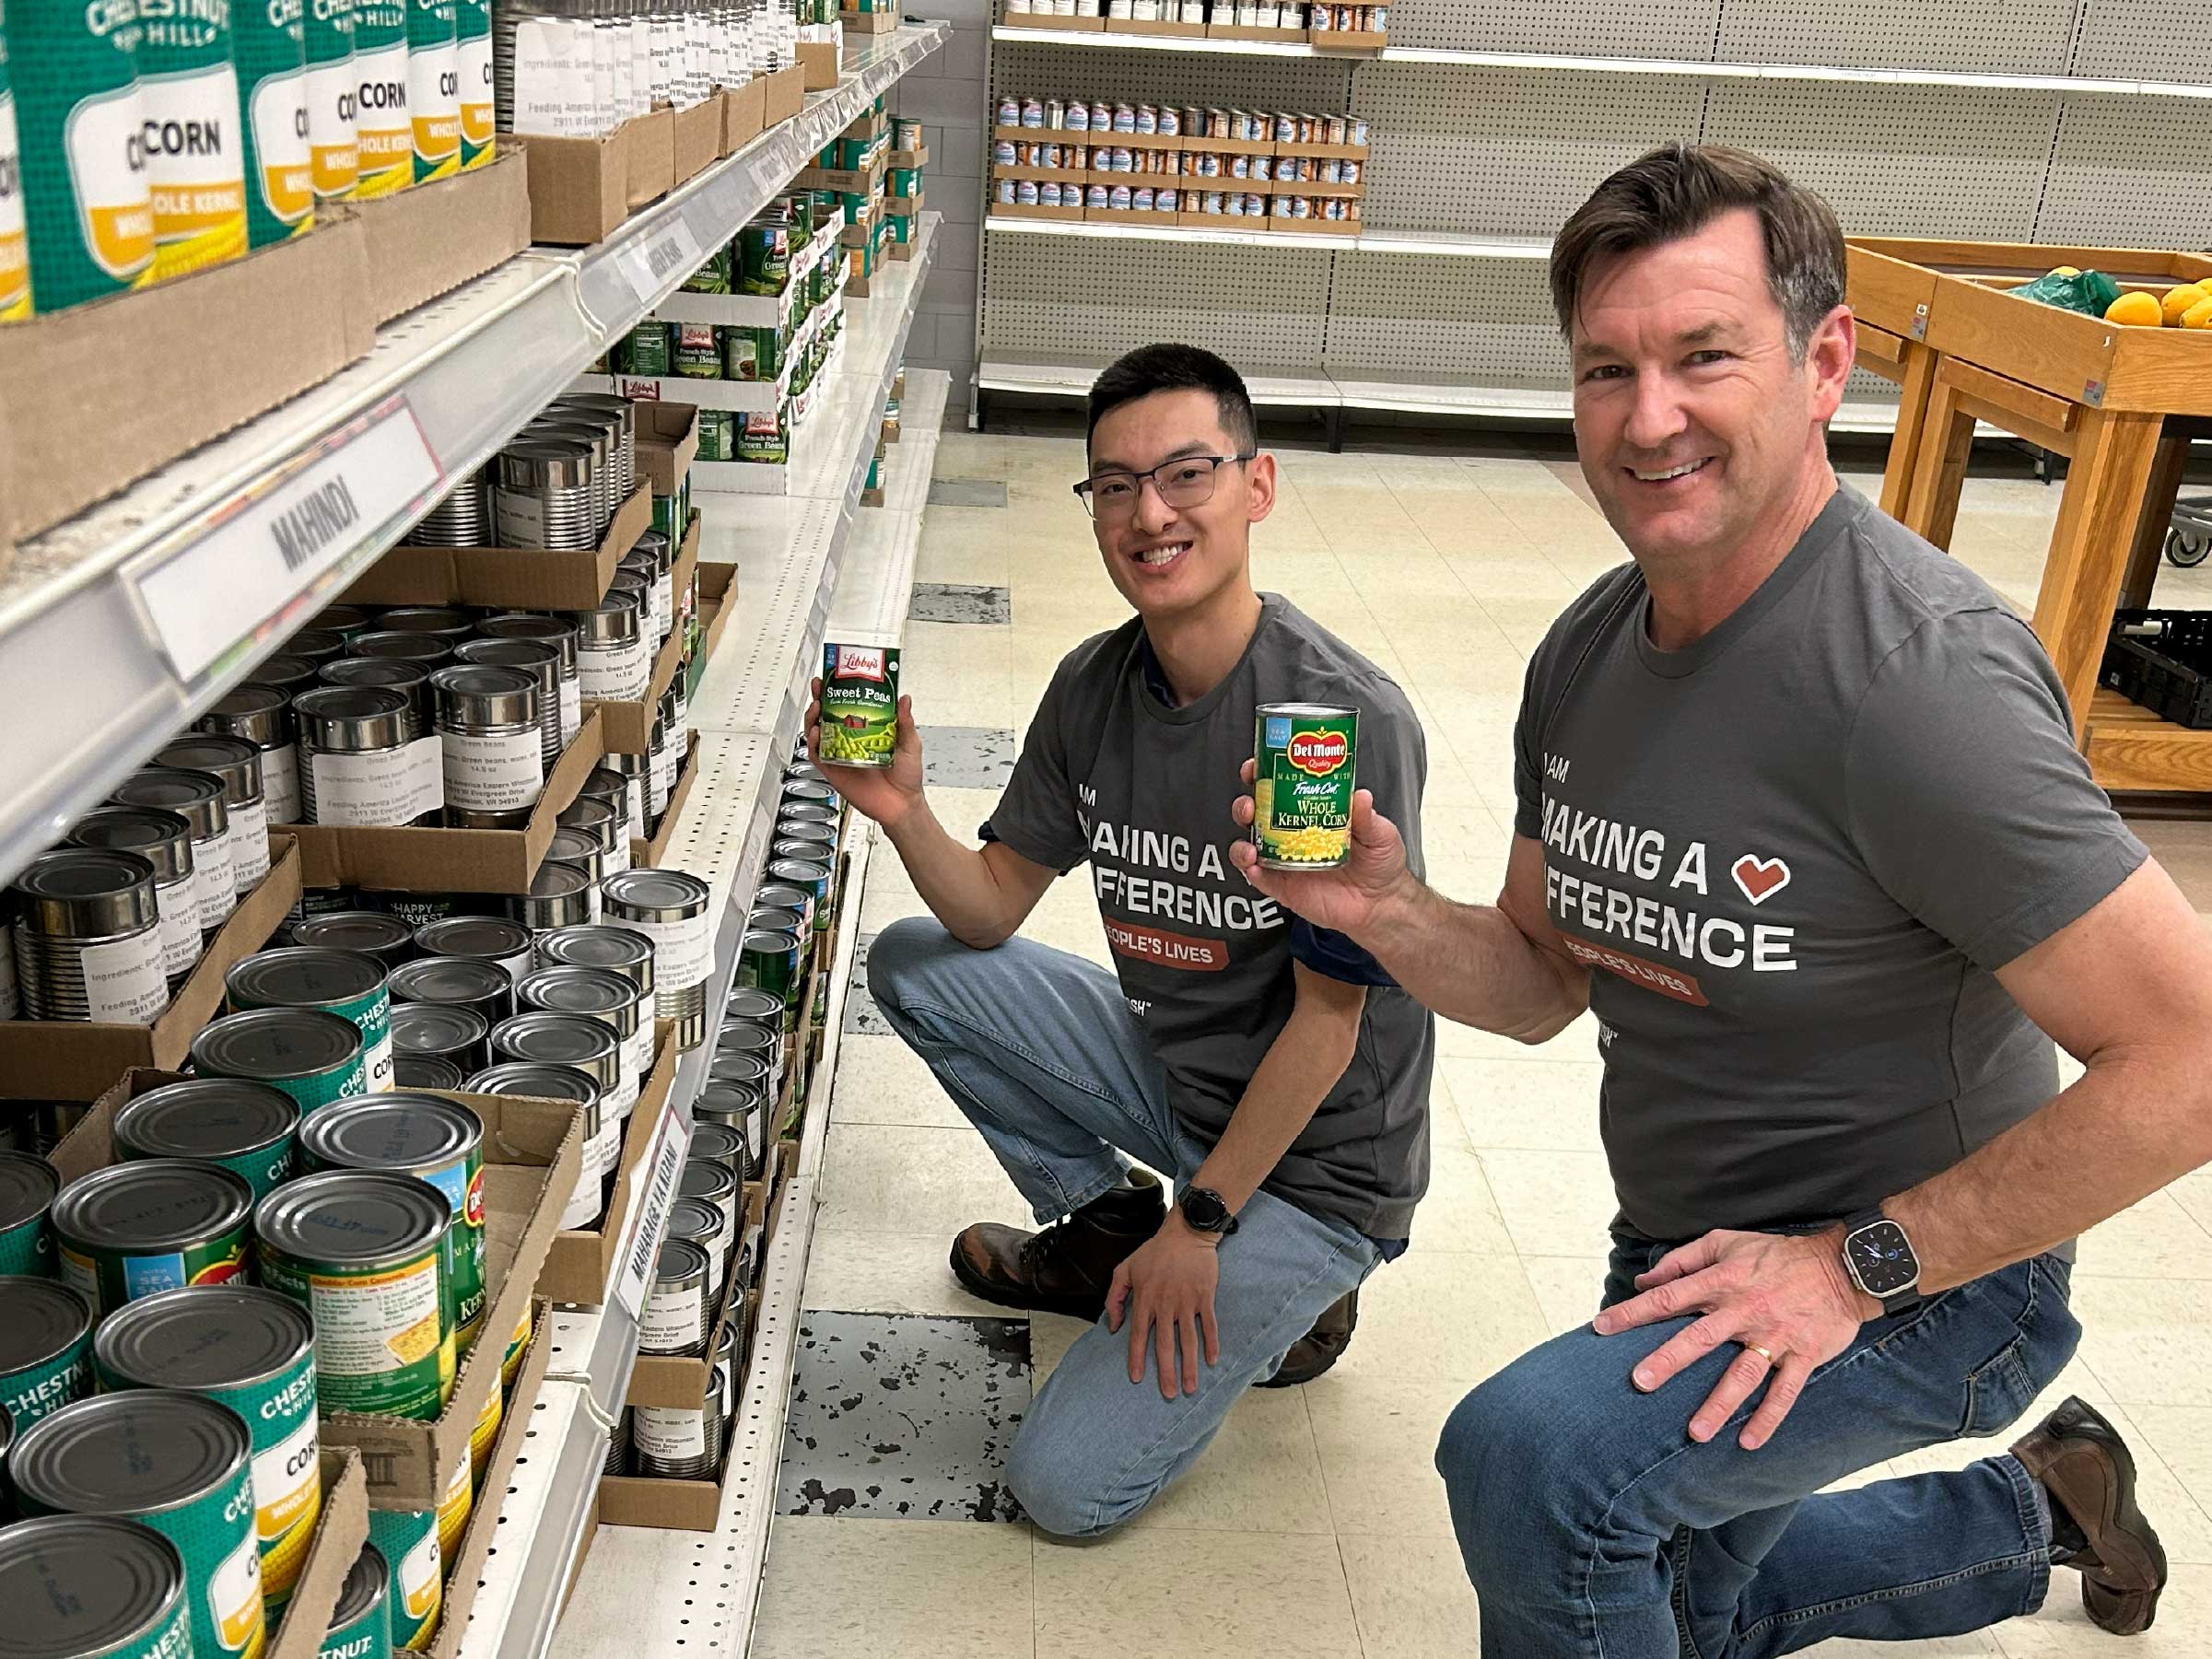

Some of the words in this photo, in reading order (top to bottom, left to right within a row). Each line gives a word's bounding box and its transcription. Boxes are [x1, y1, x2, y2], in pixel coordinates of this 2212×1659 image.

[358, 82, 406, 109] CORN
[528, 102, 563, 114] Feeding
[143, 120, 221, 156] CORN
[270, 473, 361, 575] MAHINDI
[843, 652, 879, 671] Libby's
[826, 686, 861, 698] Sweet
[864, 687, 891, 704] Peas
[1293, 743, 1312, 757] Del
[1313, 743, 1344, 757] Monte
[1307, 759, 1332, 769] Quality
[1547, 754, 1571, 783] AM
[1277, 773, 1305, 781] MADE
[1297, 800, 1336, 814] WHOLE
[1279, 812, 1320, 827] KERNEL
[1321, 813, 1347, 826] CORN
[1198, 844, 1225, 882] A
[1669, 841, 1708, 895] A
[1093, 862, 1284, 930] FFERENCE
[394, 903, 433, 915] HAPPY
[400, 912, 444, 925] ARVEST
[1546, 861, 1797, 973] FFERENCE
[1106, 924, 1162, 955] EOPLE'S
[1165, 941, 1213, 964] LIVES
[91, 963, 144, 982] Ingredients:
[1565, 941, 1637, 975] EOPLE'S
[1633, 964, 1692, 996] LIVES
[100, 999, 137, 1012] Feeding
[139, 1274, 173, 1285] SEA
